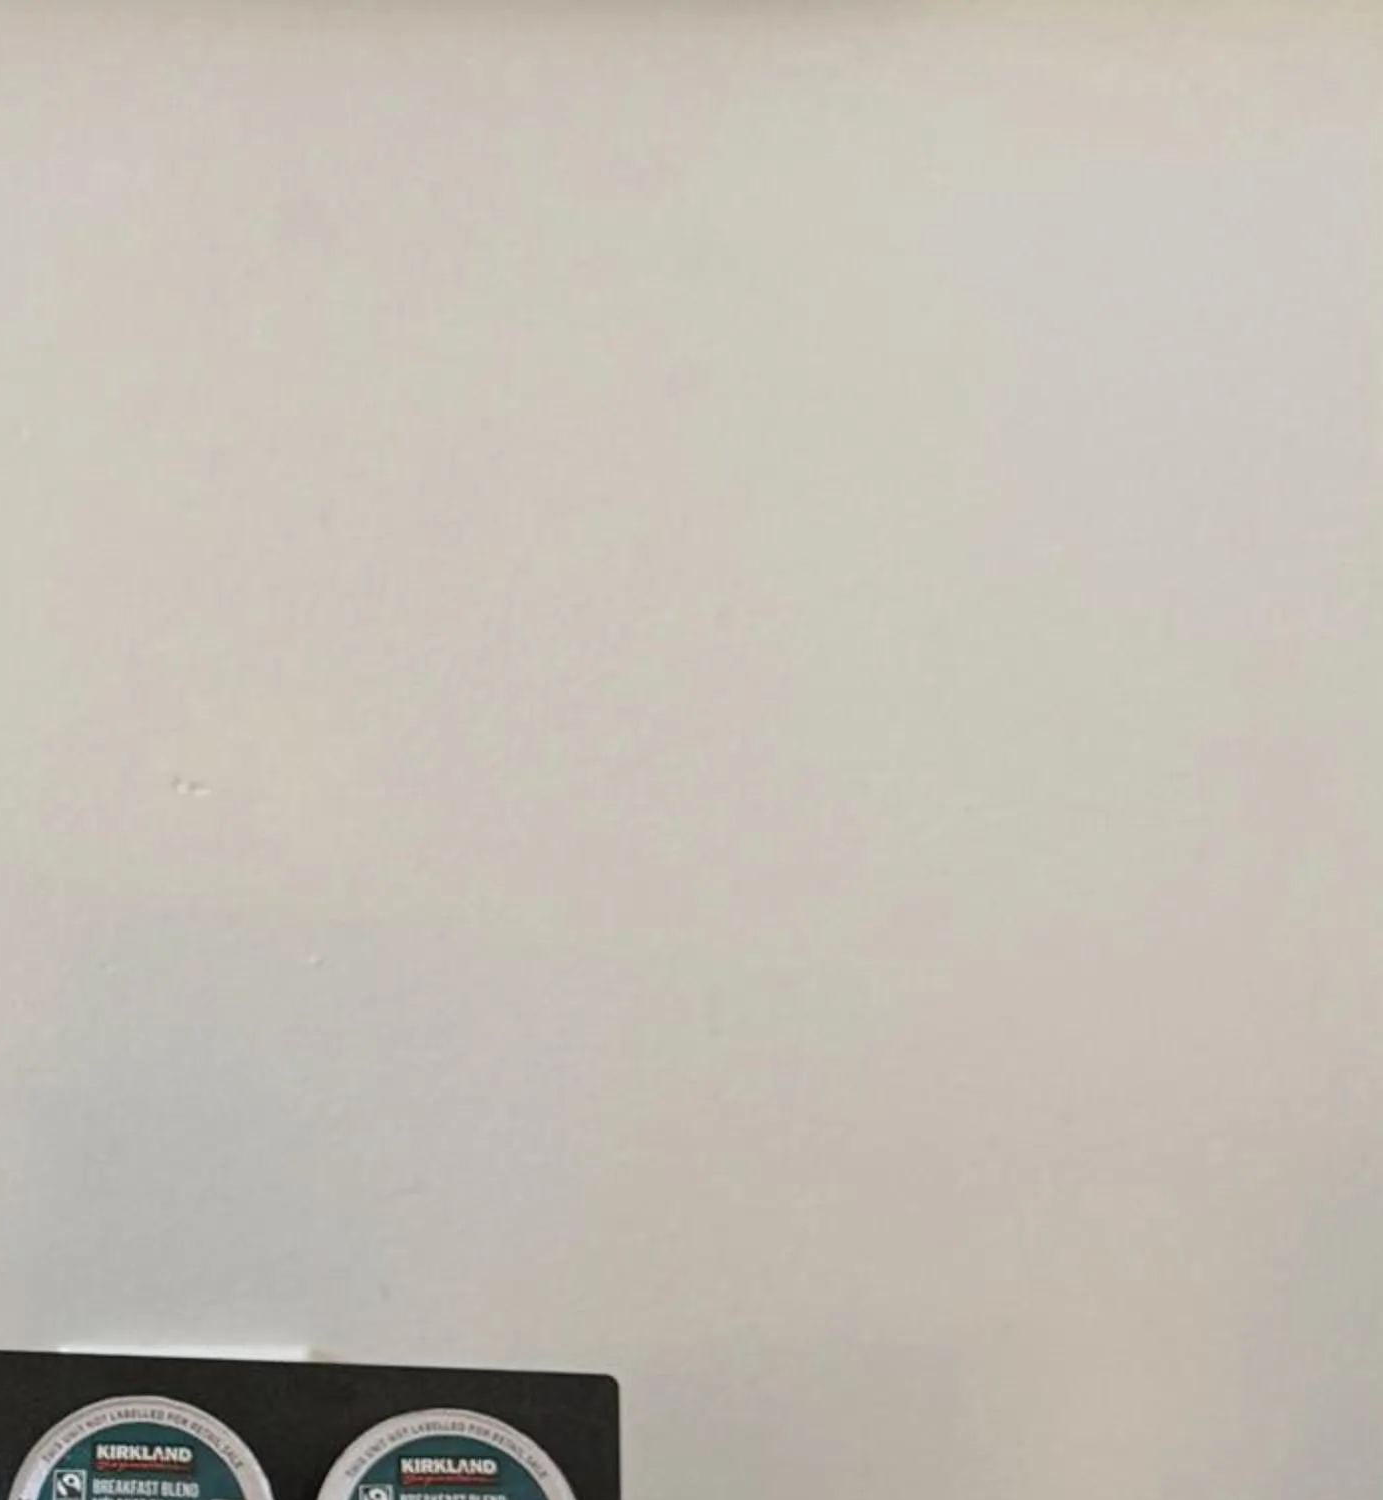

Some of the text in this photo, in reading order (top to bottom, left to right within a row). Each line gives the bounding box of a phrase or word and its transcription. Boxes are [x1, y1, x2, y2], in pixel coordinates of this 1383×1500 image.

[96, 1443, 193, 1463] KIRKLAND
[400, 1457, 497, 1475] KIRKLAND
[92, 1478, 199, 1498] BREAKFAST BLEND
